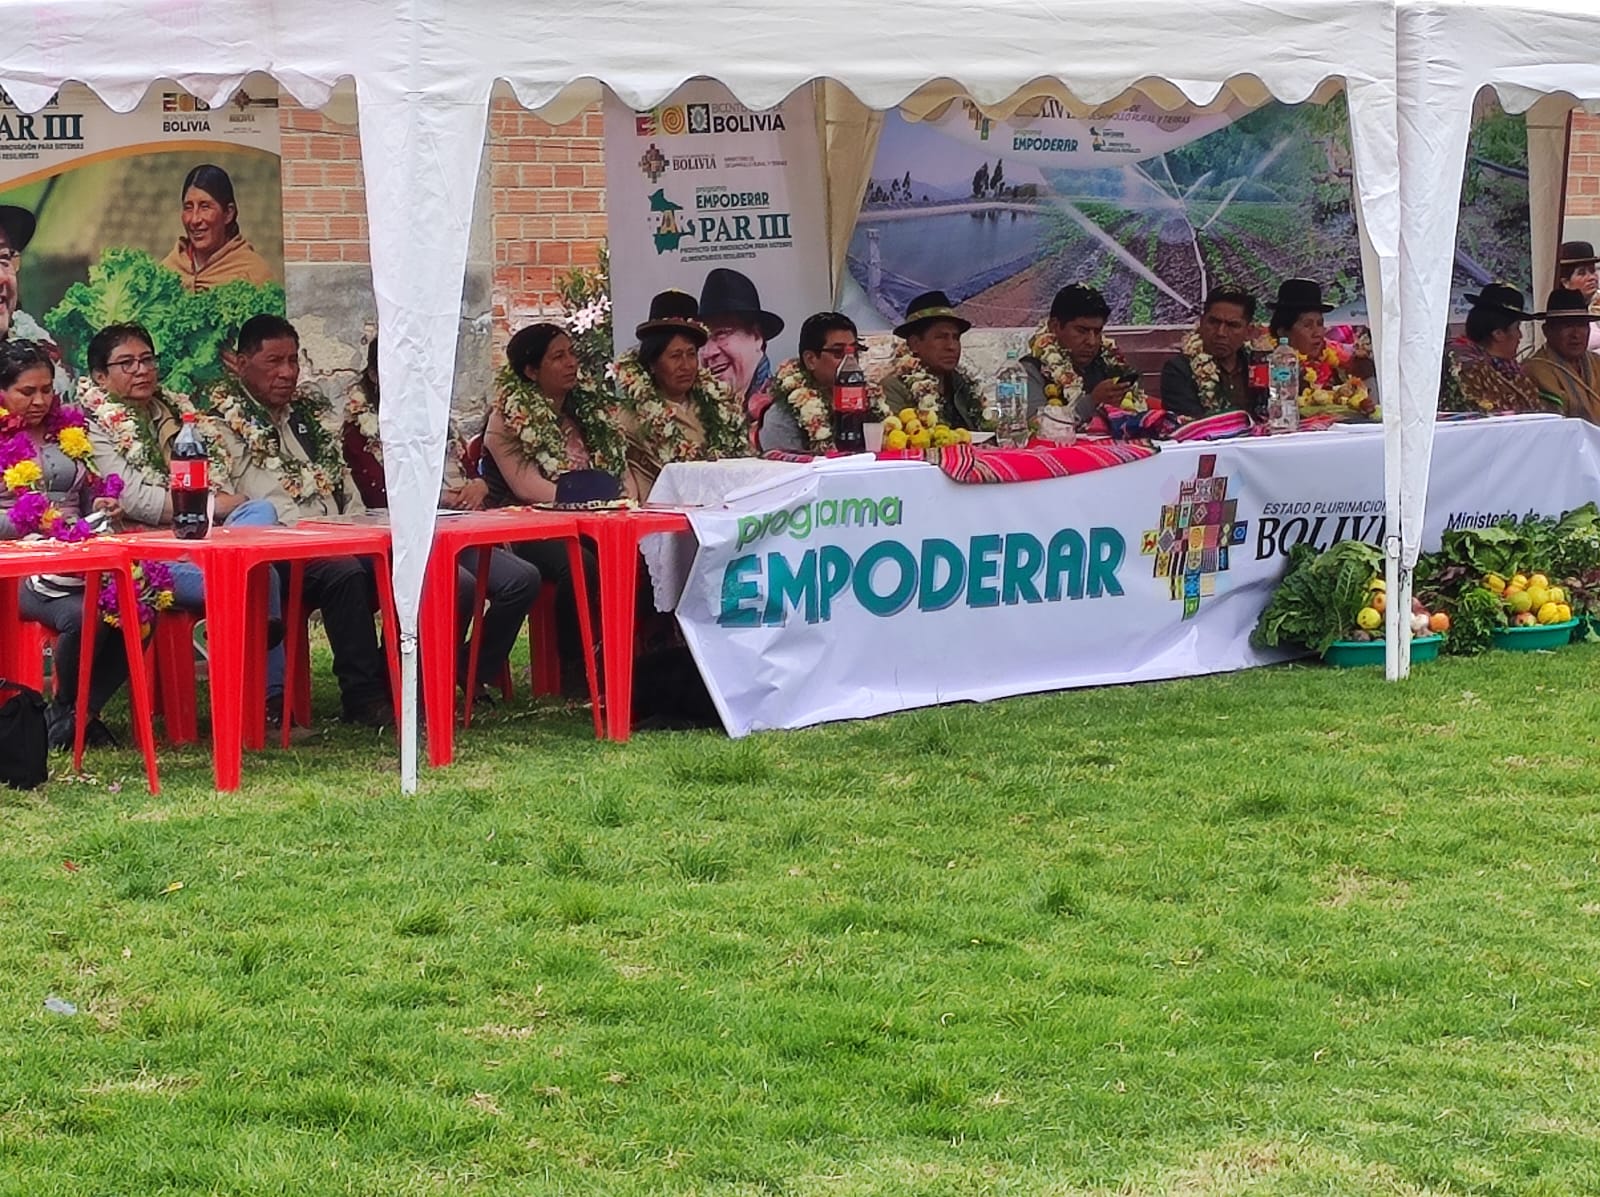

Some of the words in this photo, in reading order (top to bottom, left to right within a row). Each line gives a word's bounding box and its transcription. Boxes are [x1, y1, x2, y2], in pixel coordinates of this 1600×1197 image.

[43, 114, 84, 140] III
[163, 120, 211, 132] BOLIVIA
[713, 114, 786, 133] BOLIVIA
[1013, 137, 1078, 152] EMPODERAR
[673, 157, 717, 171] BOLIVIA
[696, 192, 769, 209] EMPODERAR
[698, 214, 755, 243] PAR
[757, 213, 792, 240] III
[1263, 502, 1311, 515] ESTADO
[1312, 500, 1386, 514] PLURINACIO
[1255, 515, 1386, 560] BOLIVI
[718, 526, 1126, 628] EMPODERAR
